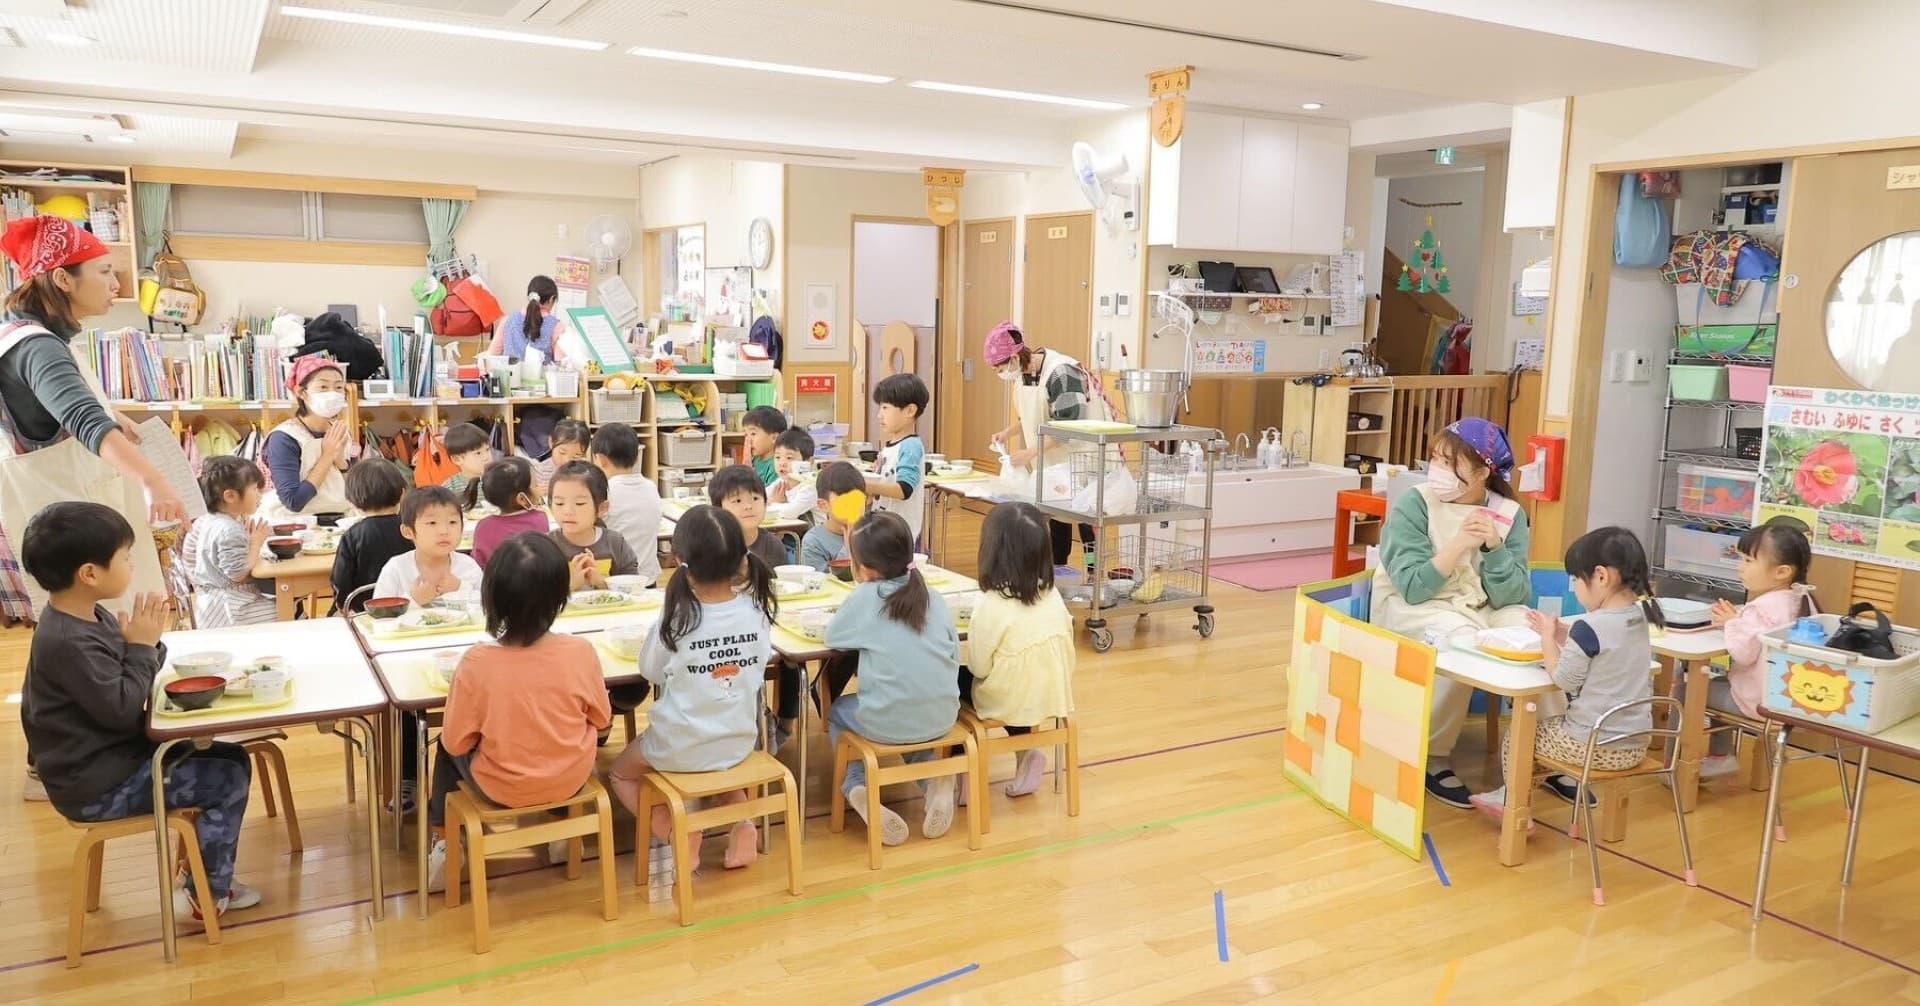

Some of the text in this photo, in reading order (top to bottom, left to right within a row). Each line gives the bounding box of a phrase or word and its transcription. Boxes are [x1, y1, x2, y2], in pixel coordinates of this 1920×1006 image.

[1892, 171, 1920, 184] シャ
[1791, 409, 1826, 426] さむい
[1834, 412, 1872, 430] ふゆに
[1880, 415, 1904, 434] さく
[689, 633, 758, 650] JUST PLAIN
[709, 648, 741, 660] COOL
